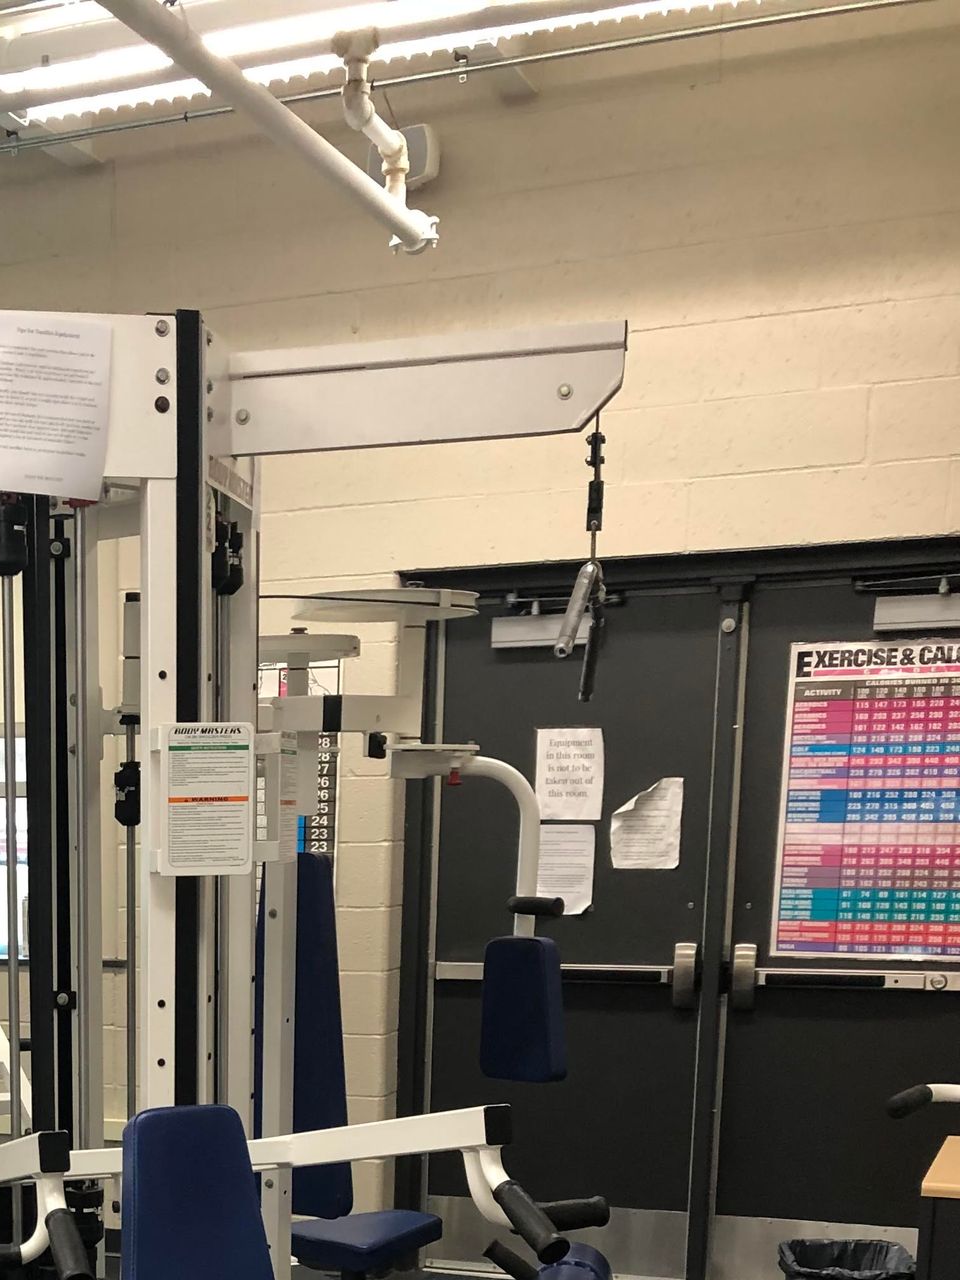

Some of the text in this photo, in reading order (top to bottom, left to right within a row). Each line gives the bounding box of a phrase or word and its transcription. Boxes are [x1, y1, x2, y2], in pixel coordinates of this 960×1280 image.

[796, 648, 898, 677] EXERCISE
[900, 648, 916, 666] &
[804, 689, 842, 697] ACTIVITY
[549, 739, 592, 748] Equipment
[556, 751, 570, 760] this
[582, 764, 592, 772] be
[545, 777, 568, 785] taken
[584, 776, 594, 784] of
[548, 789, 563, 797] this
[311, 816, 328, 826] 24
[311, 829, 328, 840] 23
[310, 842, 328, 852] 23
